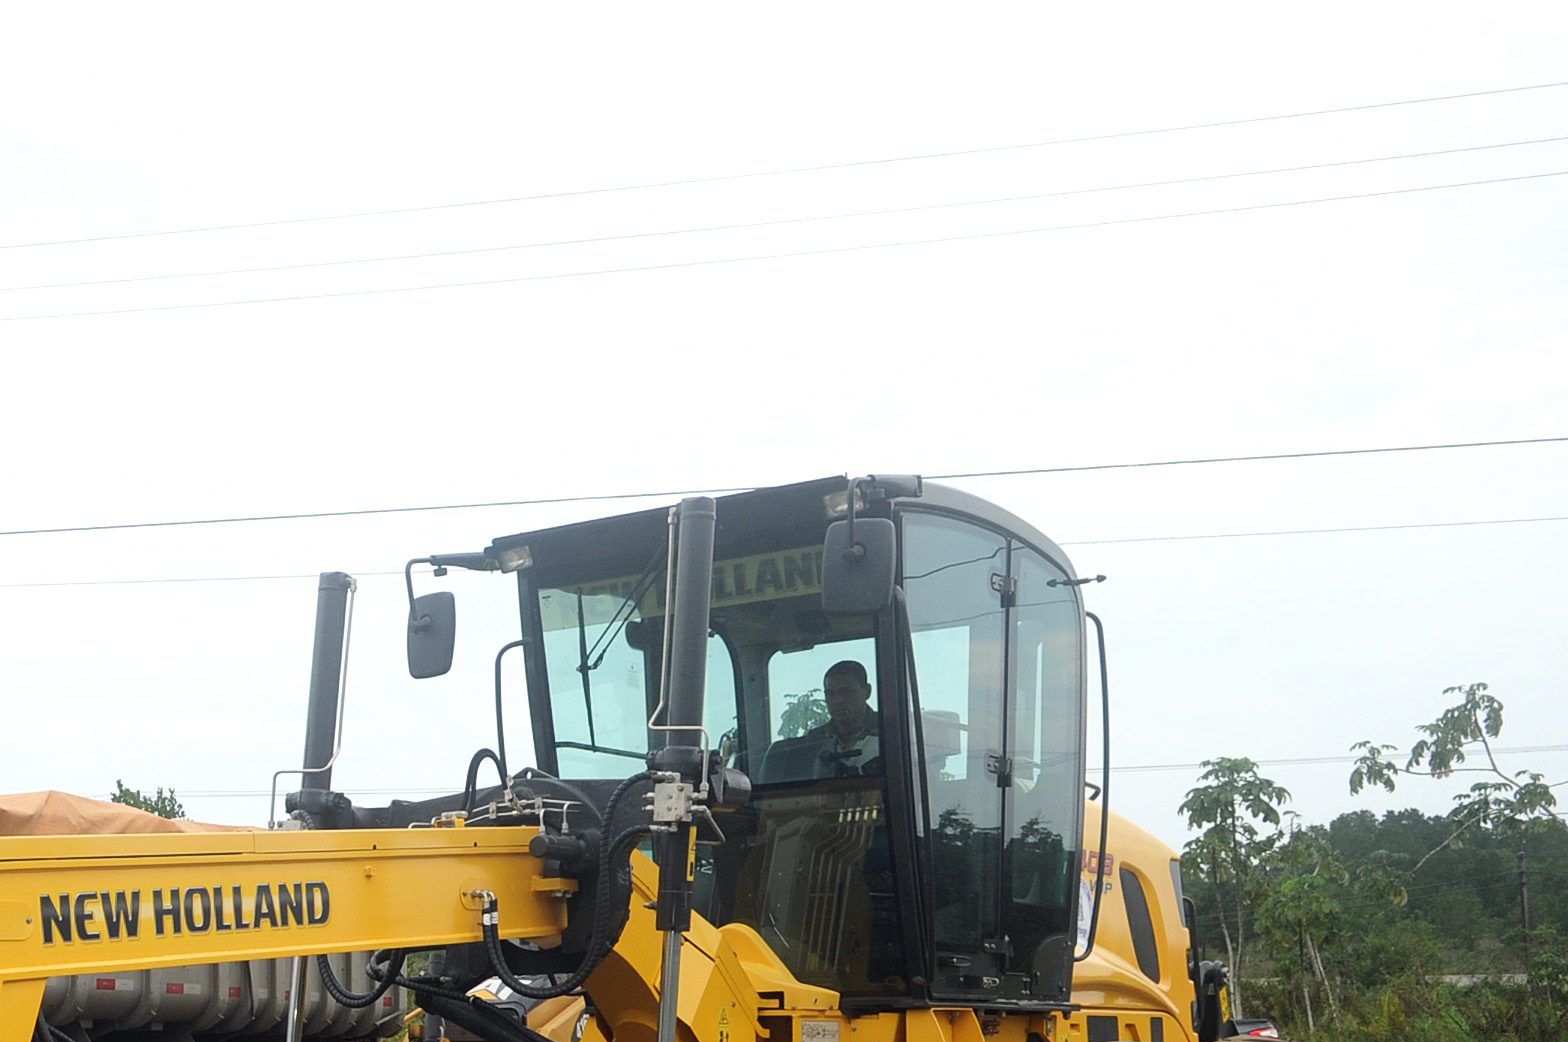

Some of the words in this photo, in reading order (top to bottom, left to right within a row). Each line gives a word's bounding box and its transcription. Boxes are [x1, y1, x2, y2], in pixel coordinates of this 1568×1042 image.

[1090, 880, 1114, 895] VP
[39, 889, 141, 945] NEW
[152, 880, 331, 937] HOLLAND
